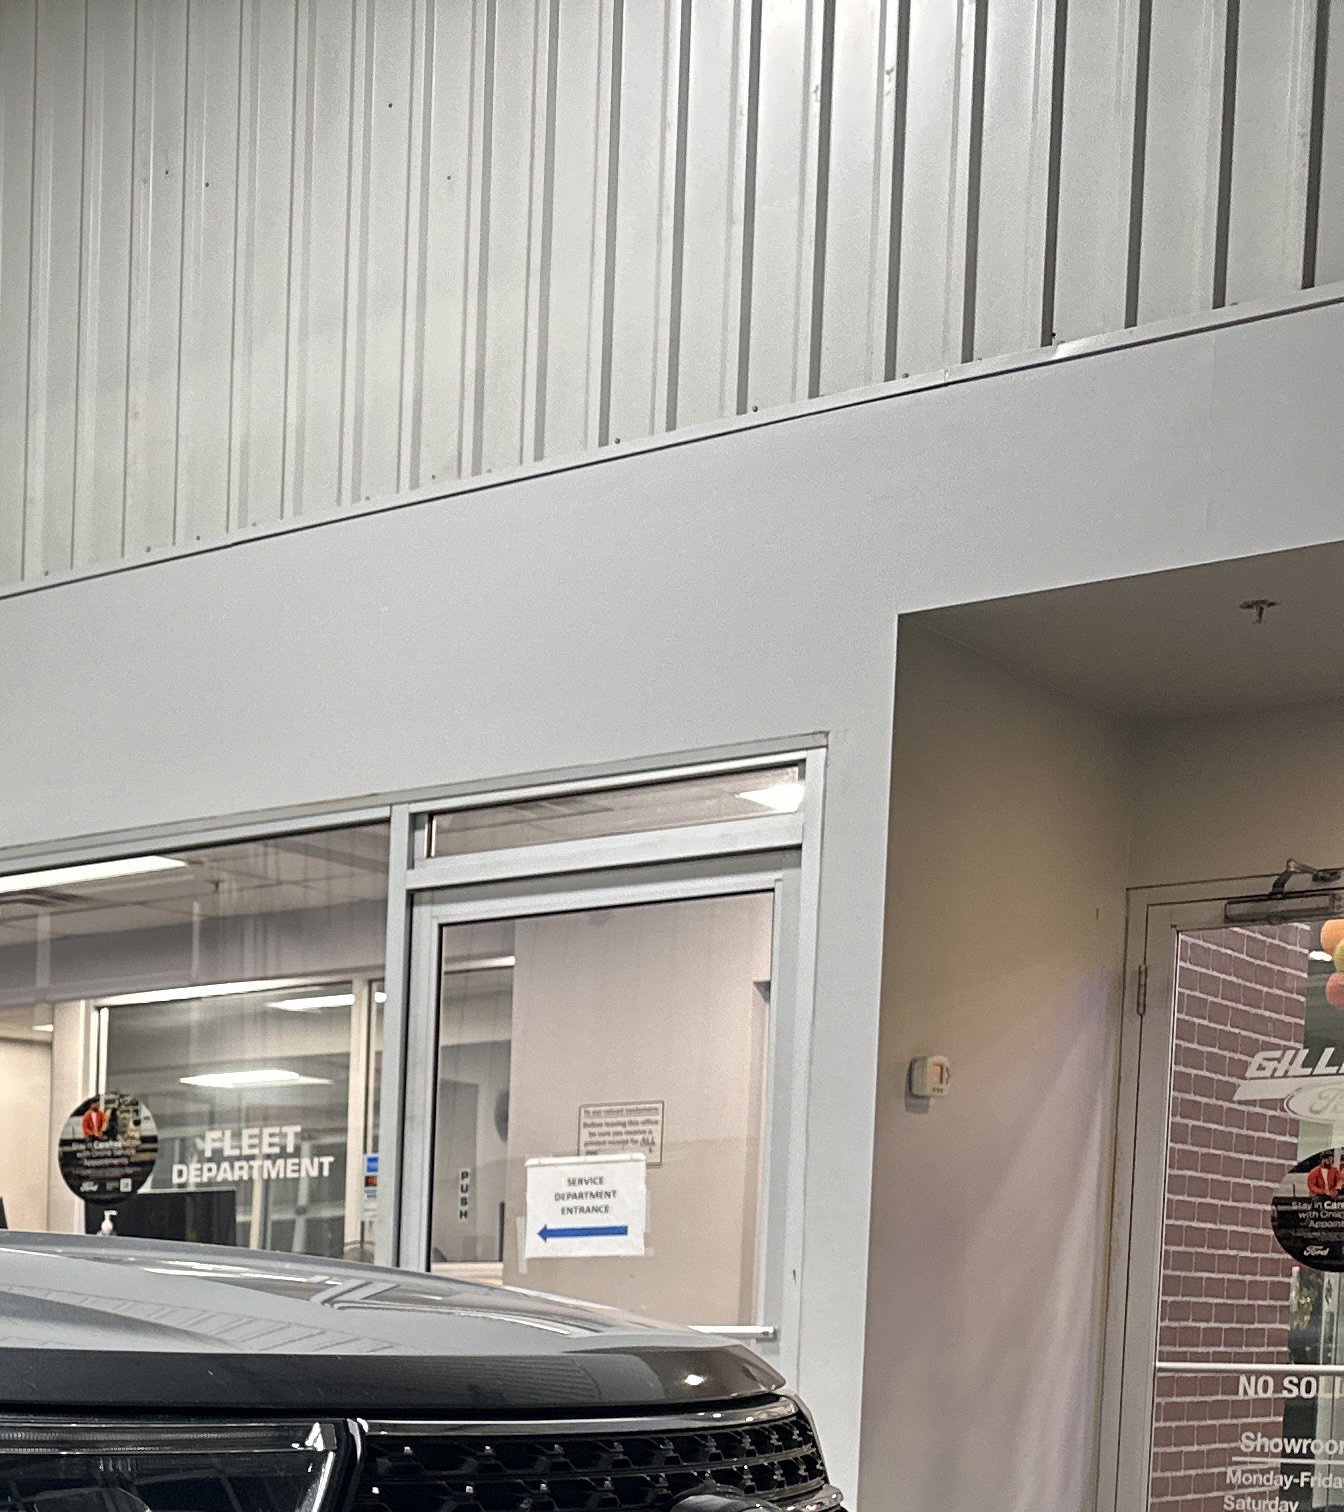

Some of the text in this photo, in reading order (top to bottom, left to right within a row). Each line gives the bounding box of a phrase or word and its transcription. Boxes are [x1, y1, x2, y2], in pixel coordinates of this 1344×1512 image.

[1245, 1047, 1344, 1078] GILL
[203, 1125, 302, 1158] FLEET
[172, 1156, 335, 1184] DEPARTMENT
[567, 1176, 605, 1186] SERVICE
[459, 1171, 469, 1220] PUSH
[554, 1190, 617, 1201] DEPARTMENT
[561, 1205, 610, 1216] ENTRANCE
[1304, 1245, 1330, 1256] Ford
[1238, 1375, 1274, 1399] NO
[1226, 1467, 1344, 1490] Monday-Frida
